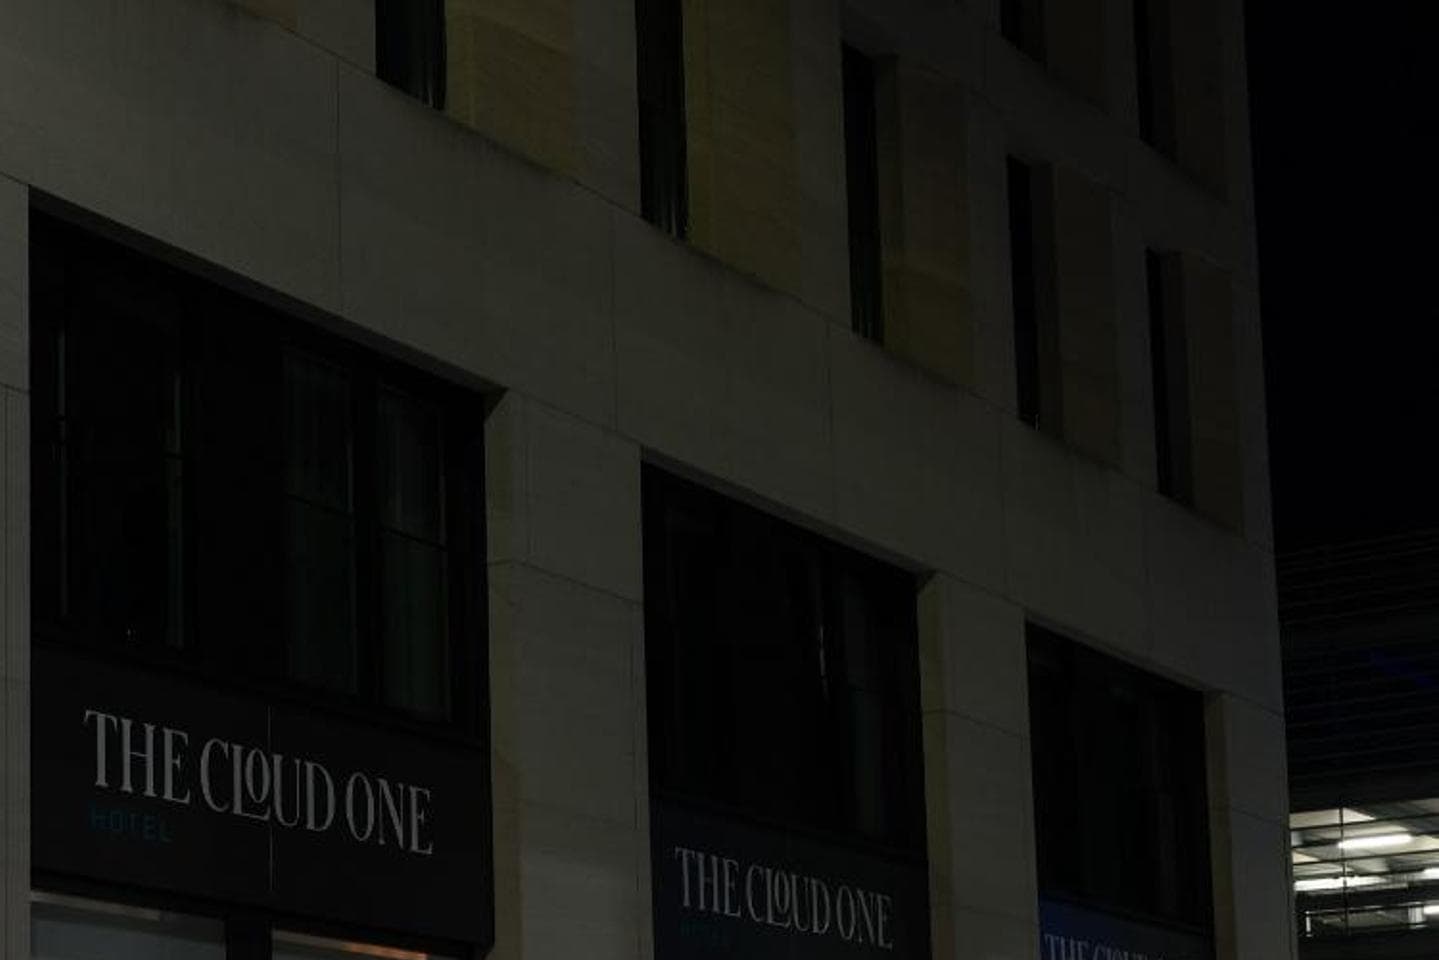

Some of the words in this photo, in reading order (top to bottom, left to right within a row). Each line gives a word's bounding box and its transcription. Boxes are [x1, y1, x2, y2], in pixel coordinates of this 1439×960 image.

[83, 709, 192, 806] THE
[200, 737, 337, 833] CLOUD
[344, 771, 435, 856] ONE
[674, 846, 742, 918] THE
[745, 864, 832, 935] CLOUD
[836, 885, 894, 951] ONE
